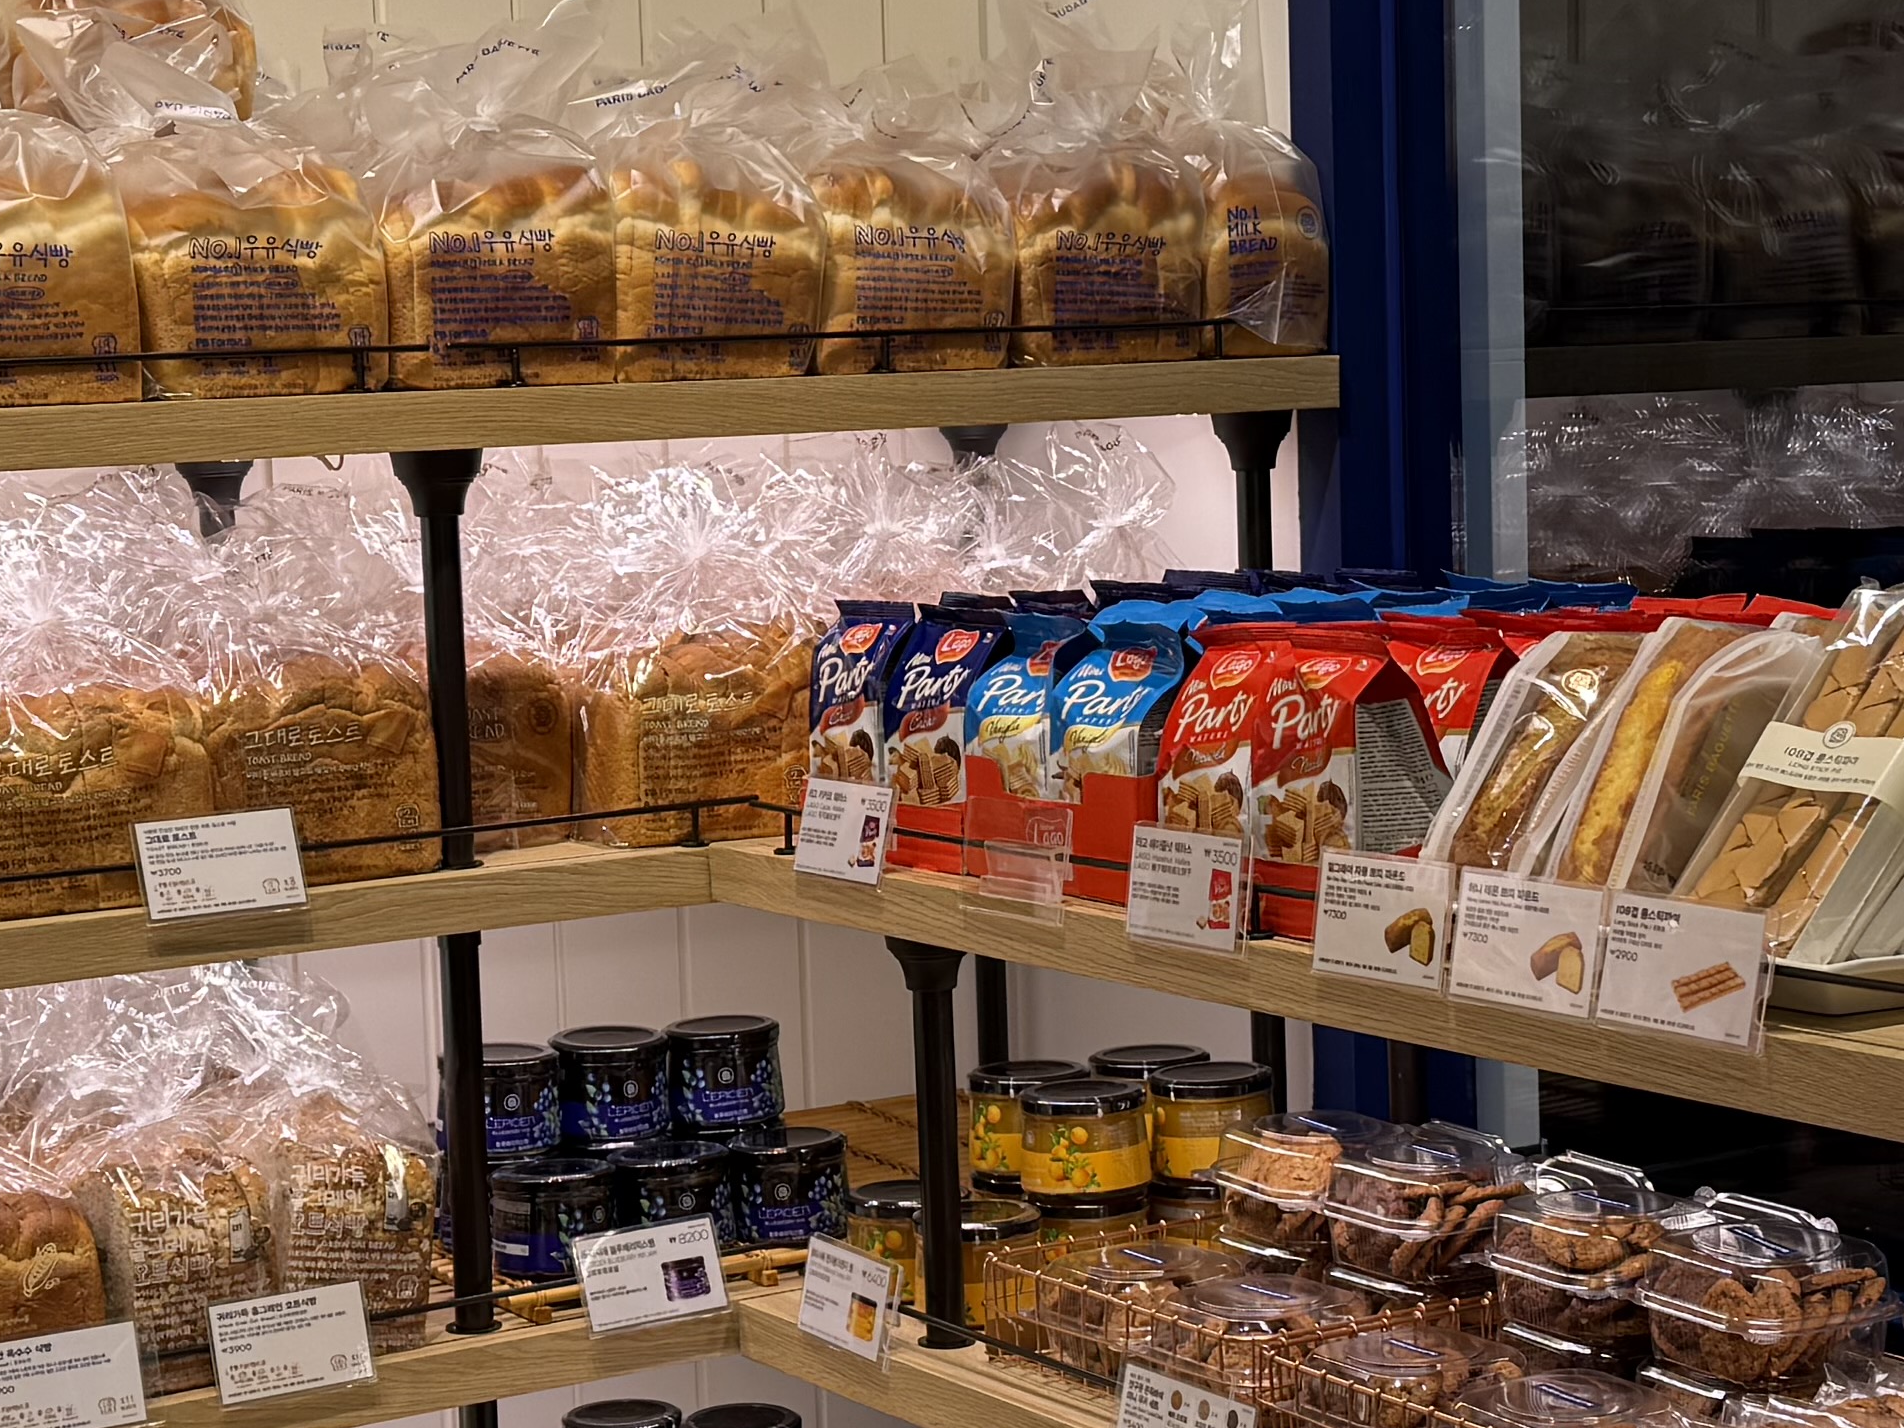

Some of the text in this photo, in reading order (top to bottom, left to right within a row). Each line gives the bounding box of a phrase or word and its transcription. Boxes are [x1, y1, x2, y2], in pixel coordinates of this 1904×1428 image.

[1228, 222, 1261, 237] MILK
[1228, 237, 1278, 255] BREAD
[940, 631, 976, 653] Lago
[1218, 655, 1254, 675] Lago
[818, 657, 873, 703] Party
[896, 665, 968, 710] Party
[1056, 679, 1148, 721] Party
[1173, 689, 1255, 743] Party
[1270, 693, 1342, 750] Party
[290, 1164, 367, 1188] 귀리가득
[129, 1207, 210, 1233] 귀리가득
